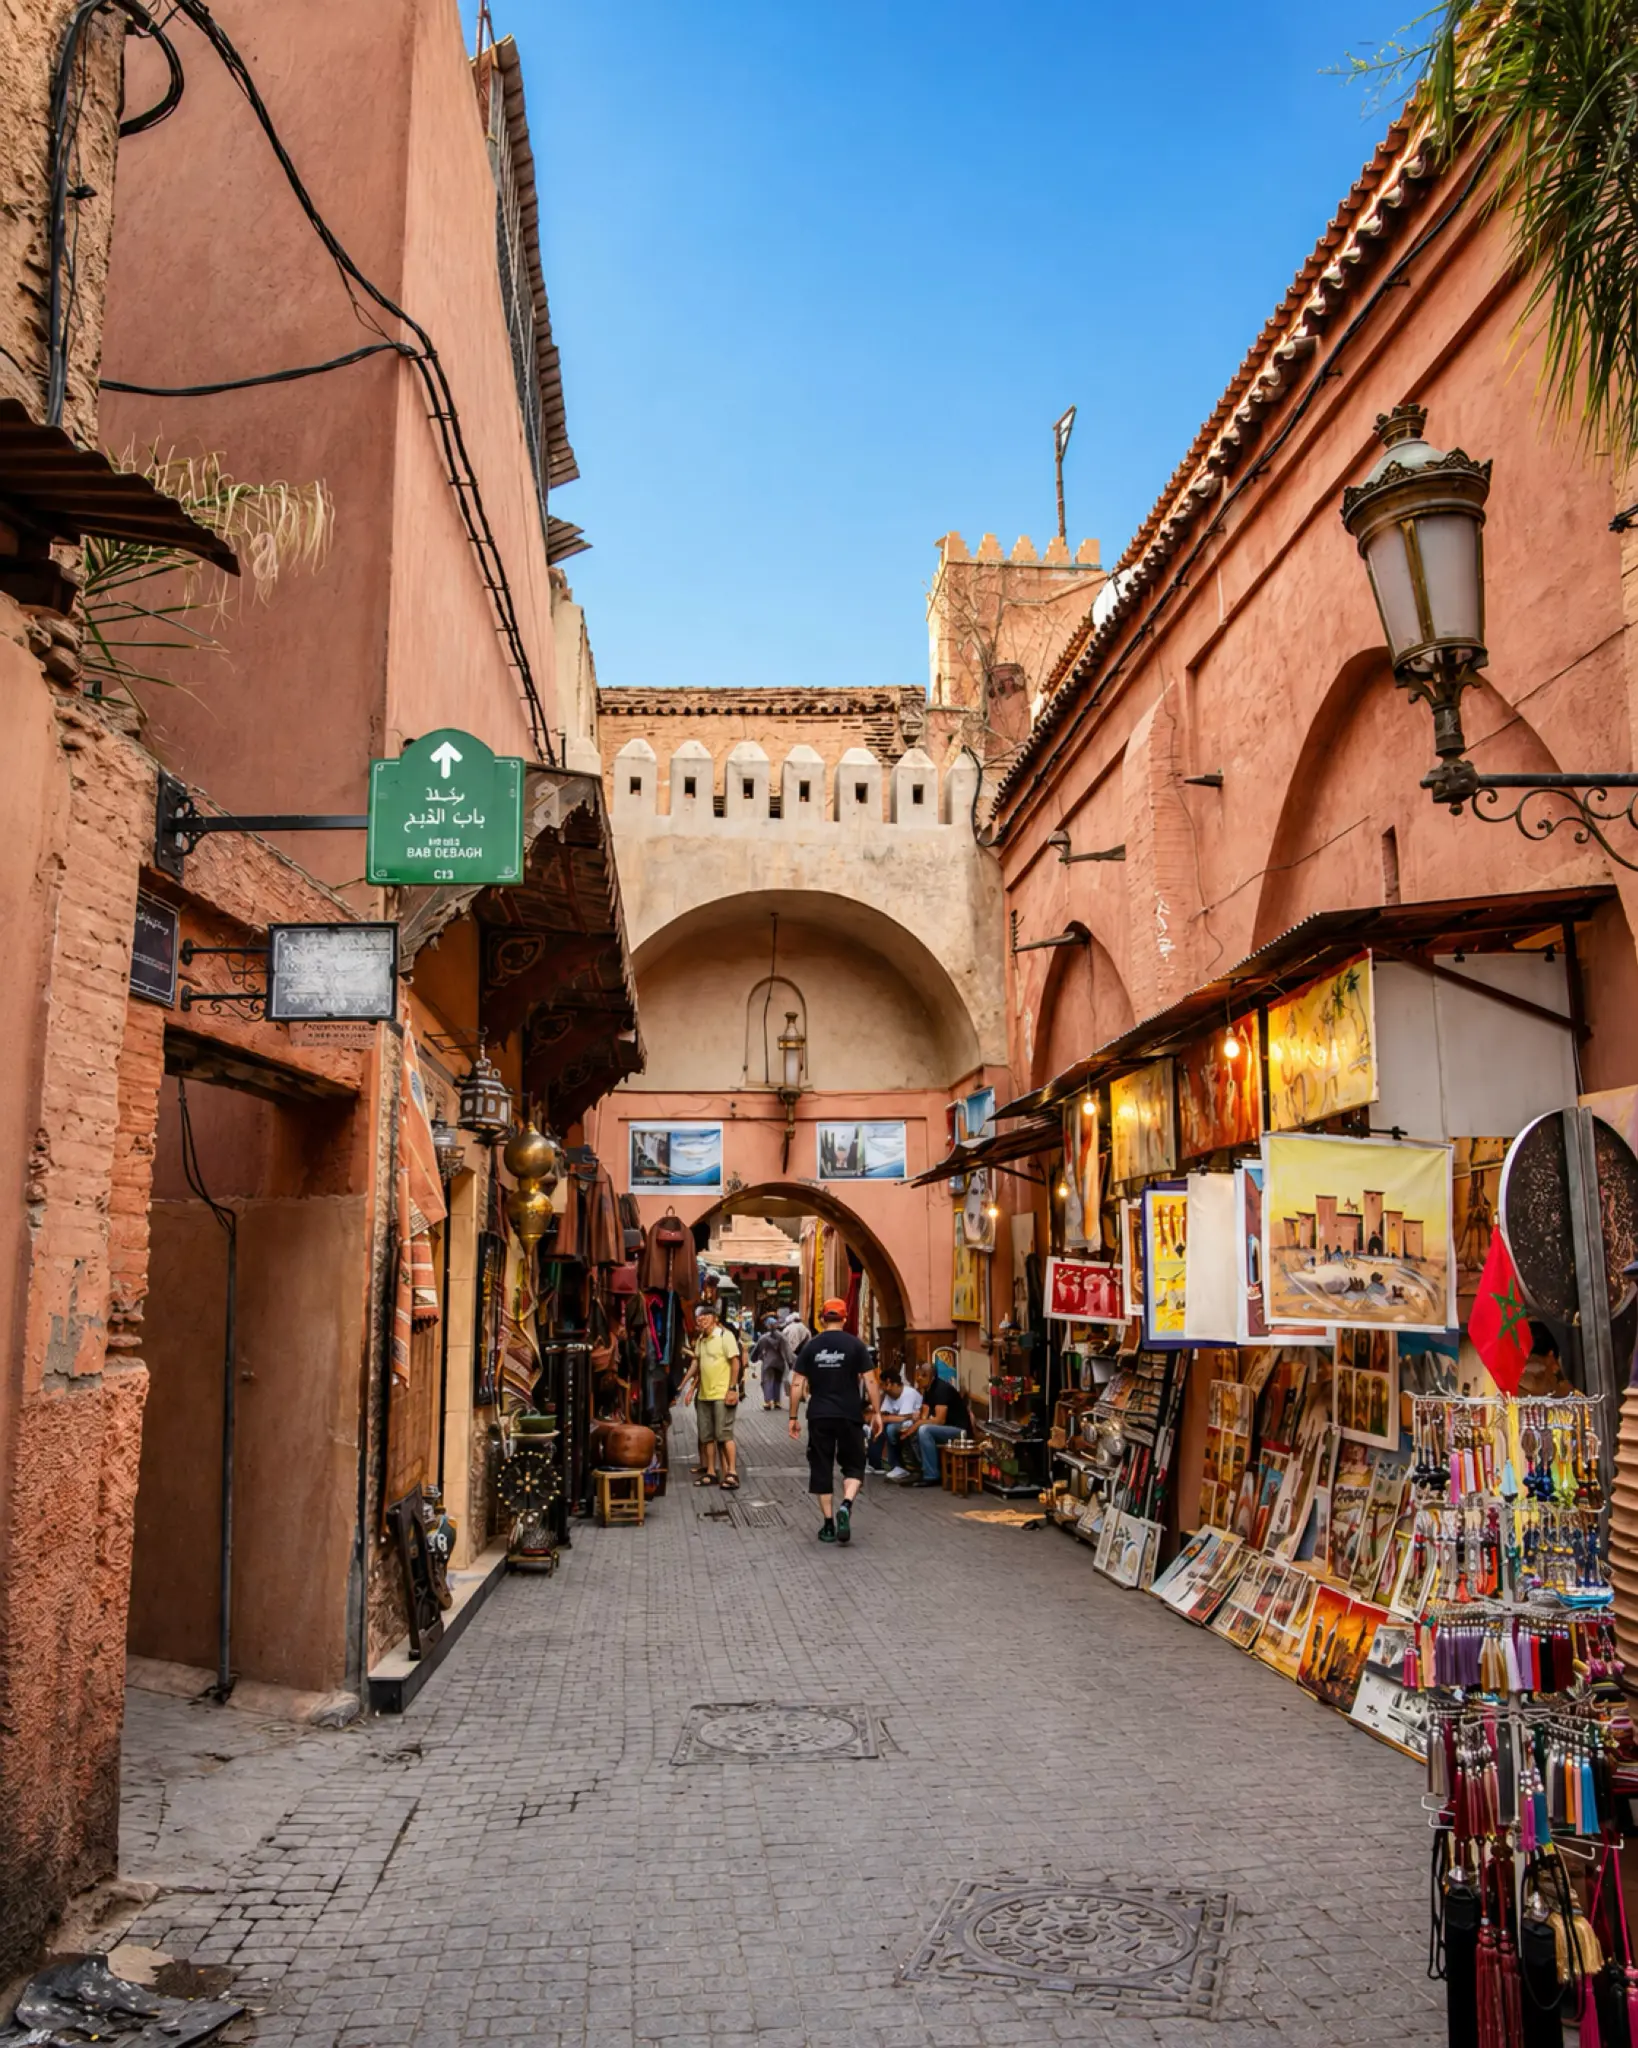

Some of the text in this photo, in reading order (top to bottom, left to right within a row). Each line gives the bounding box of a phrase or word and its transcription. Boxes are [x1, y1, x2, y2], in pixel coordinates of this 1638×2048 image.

[453, 808, 485, 828] باب
[407, 847, 482, 858] BAB DEBAGH
[433, 869, 454, 879] C13
